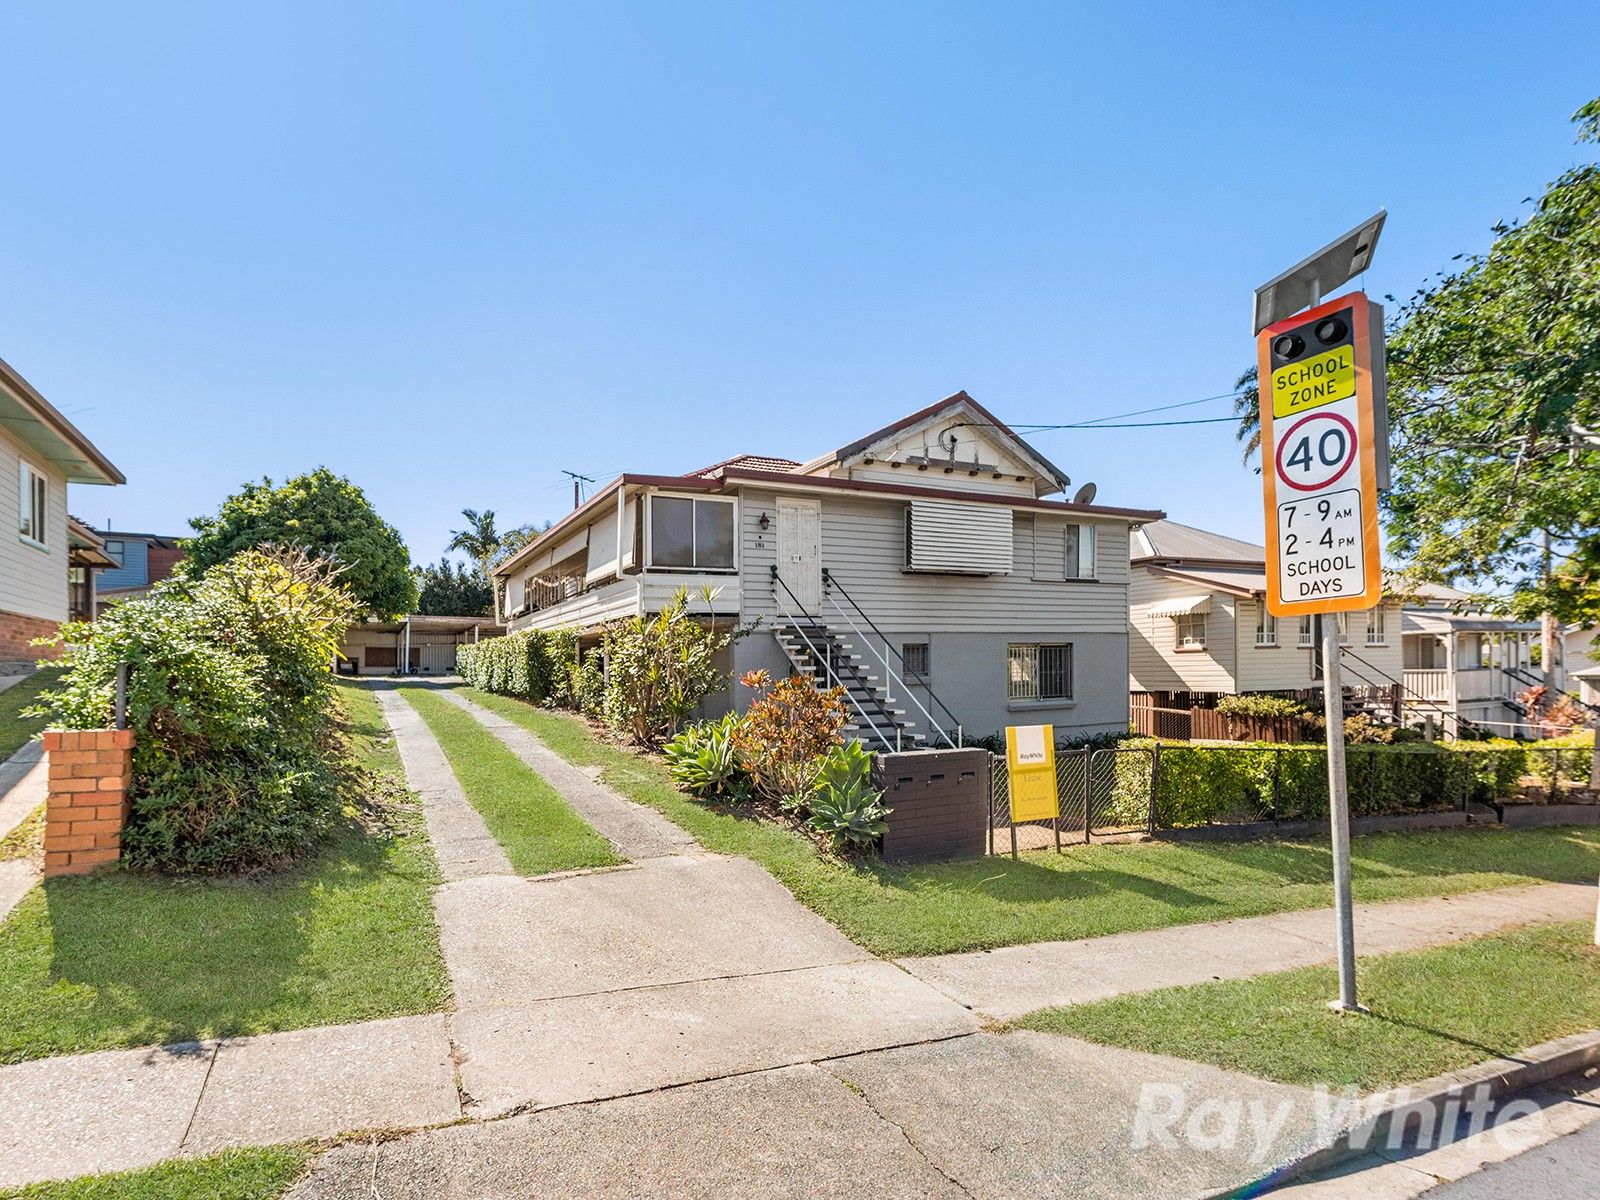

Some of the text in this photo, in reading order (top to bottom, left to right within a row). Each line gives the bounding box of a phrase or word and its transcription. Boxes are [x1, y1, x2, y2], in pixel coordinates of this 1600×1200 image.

[1276, 355, 1350, 390] SCHOOL
[1290, 378, 1337, 407] ZONE
[1286, 428, 1347, 472] 40
[1334, 508, 1352, 520] AM
[1338, 537, 1355, 548] PM
[1287, 555, 1356, 578] SCHOOL
[1300, 578, 1343, 597] DAYS
